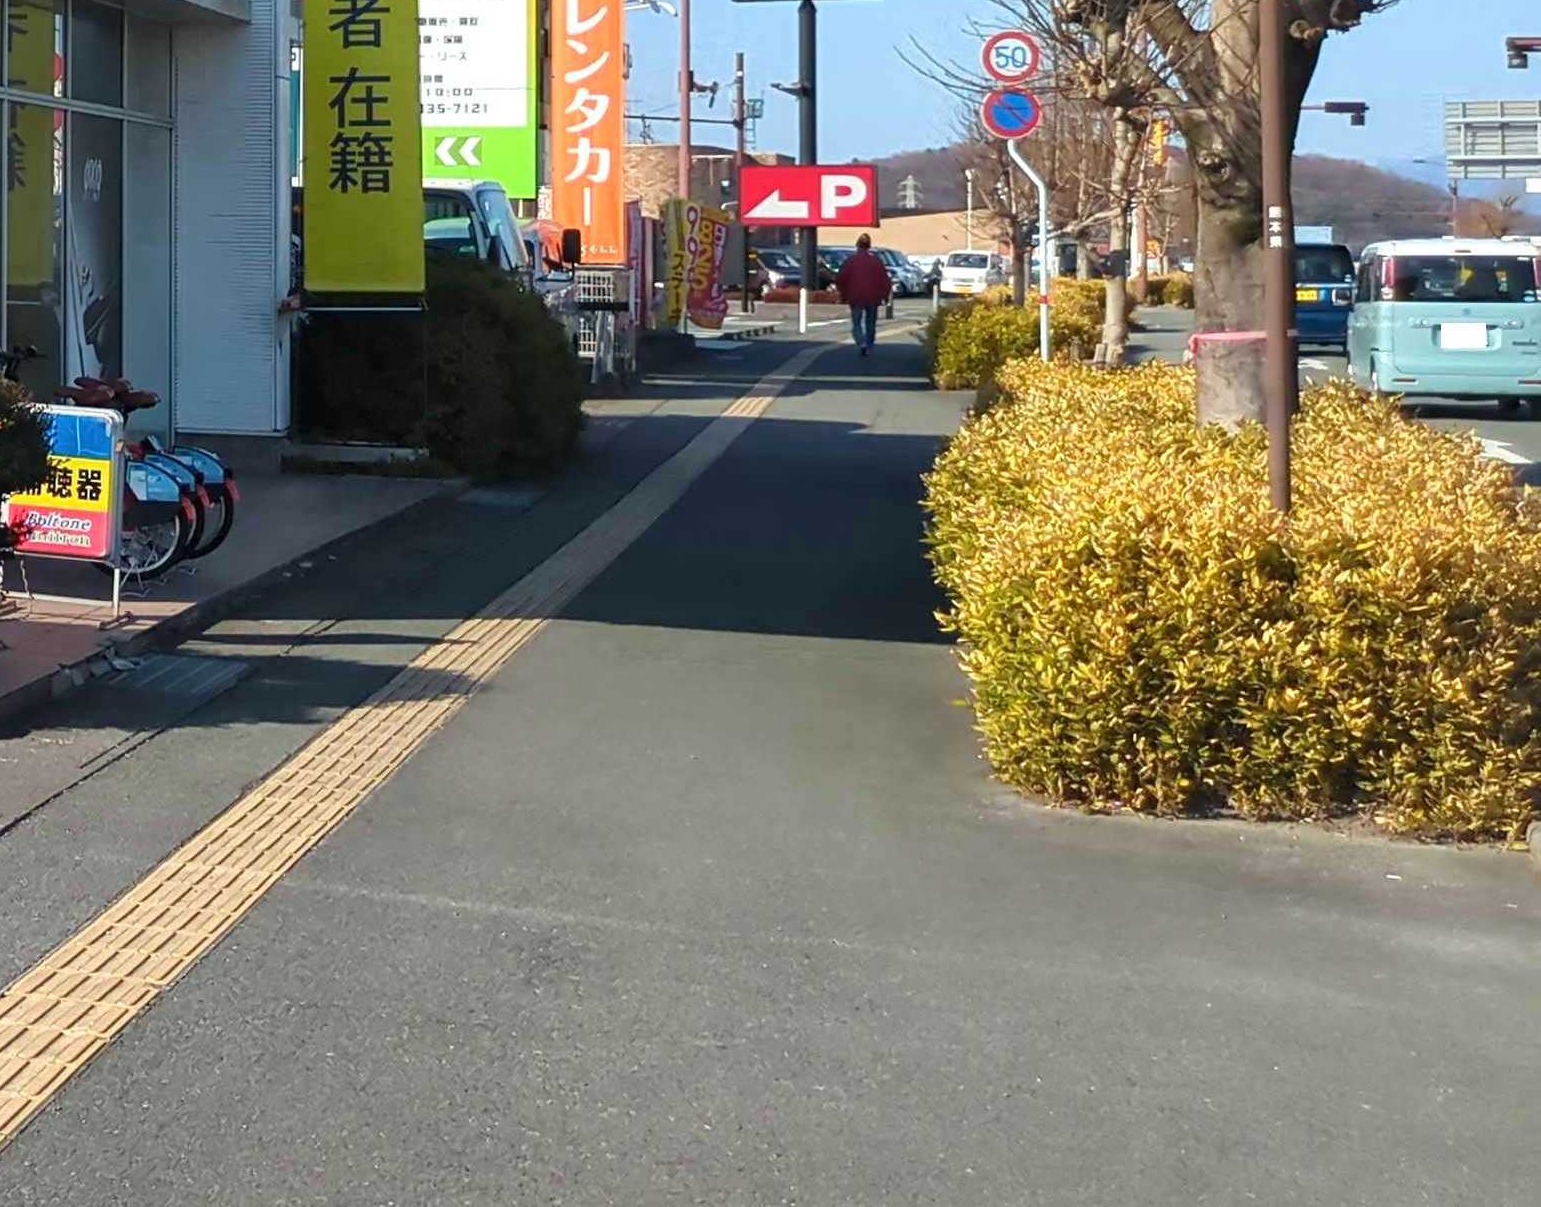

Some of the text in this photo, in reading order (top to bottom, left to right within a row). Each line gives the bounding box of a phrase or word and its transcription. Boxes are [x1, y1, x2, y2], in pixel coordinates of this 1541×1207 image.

[994, 46, 1026, 69] 50
[328, 66, 394, 195] 在籍
[821, 174, 868, 219] P
